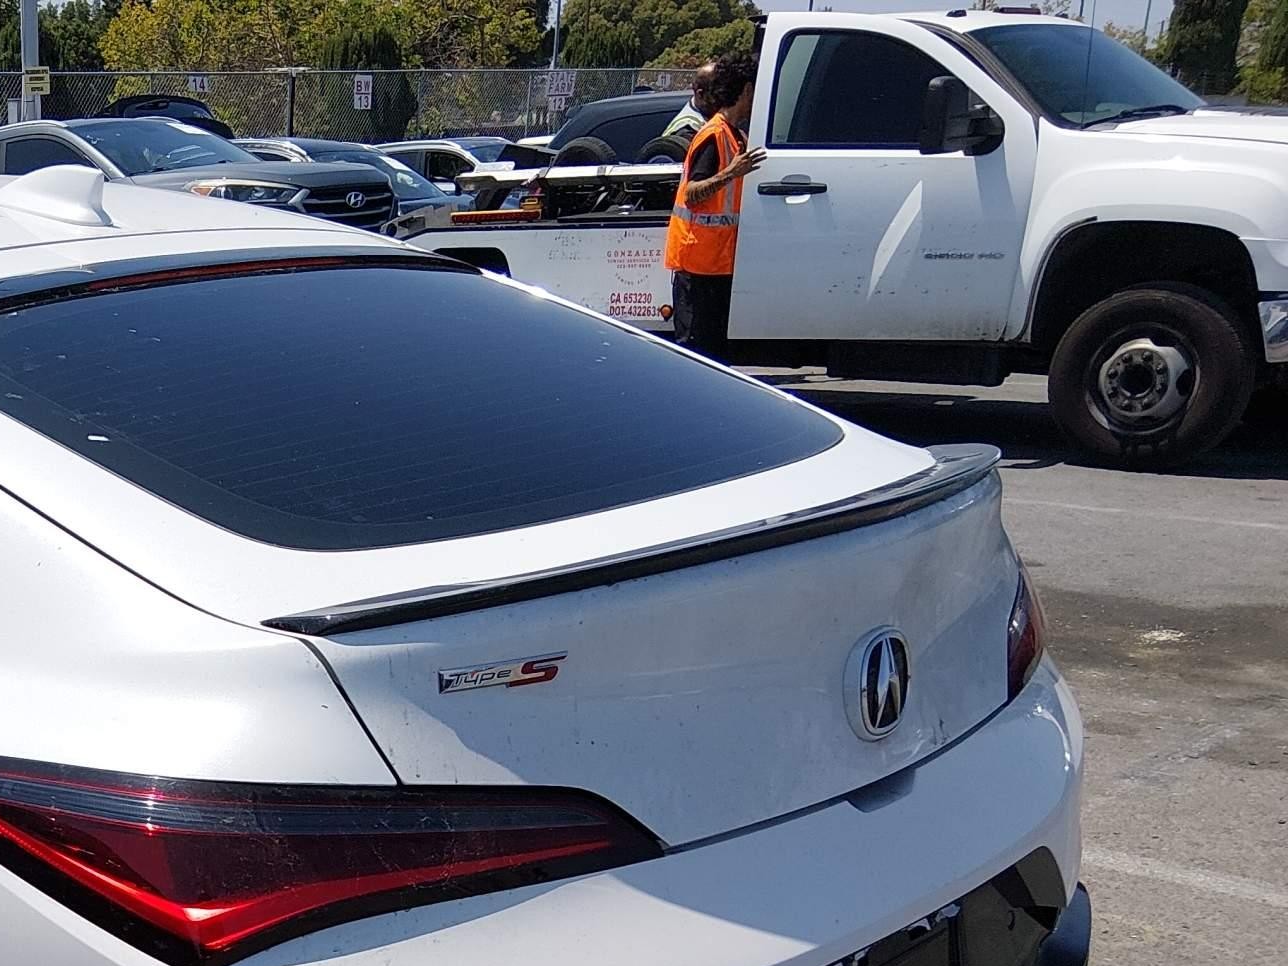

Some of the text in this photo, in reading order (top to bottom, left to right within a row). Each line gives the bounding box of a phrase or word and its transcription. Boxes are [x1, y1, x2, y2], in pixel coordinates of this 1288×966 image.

[192, 77, 206, 92] 14
[356, 80, 371, 92] BW
[358, 95, 370, 109] 13
[606, 249, 662, 258] GONZALEZ
[610, 292, 653, 304] CA 653230
[448, 654, 569, 689] Type S
